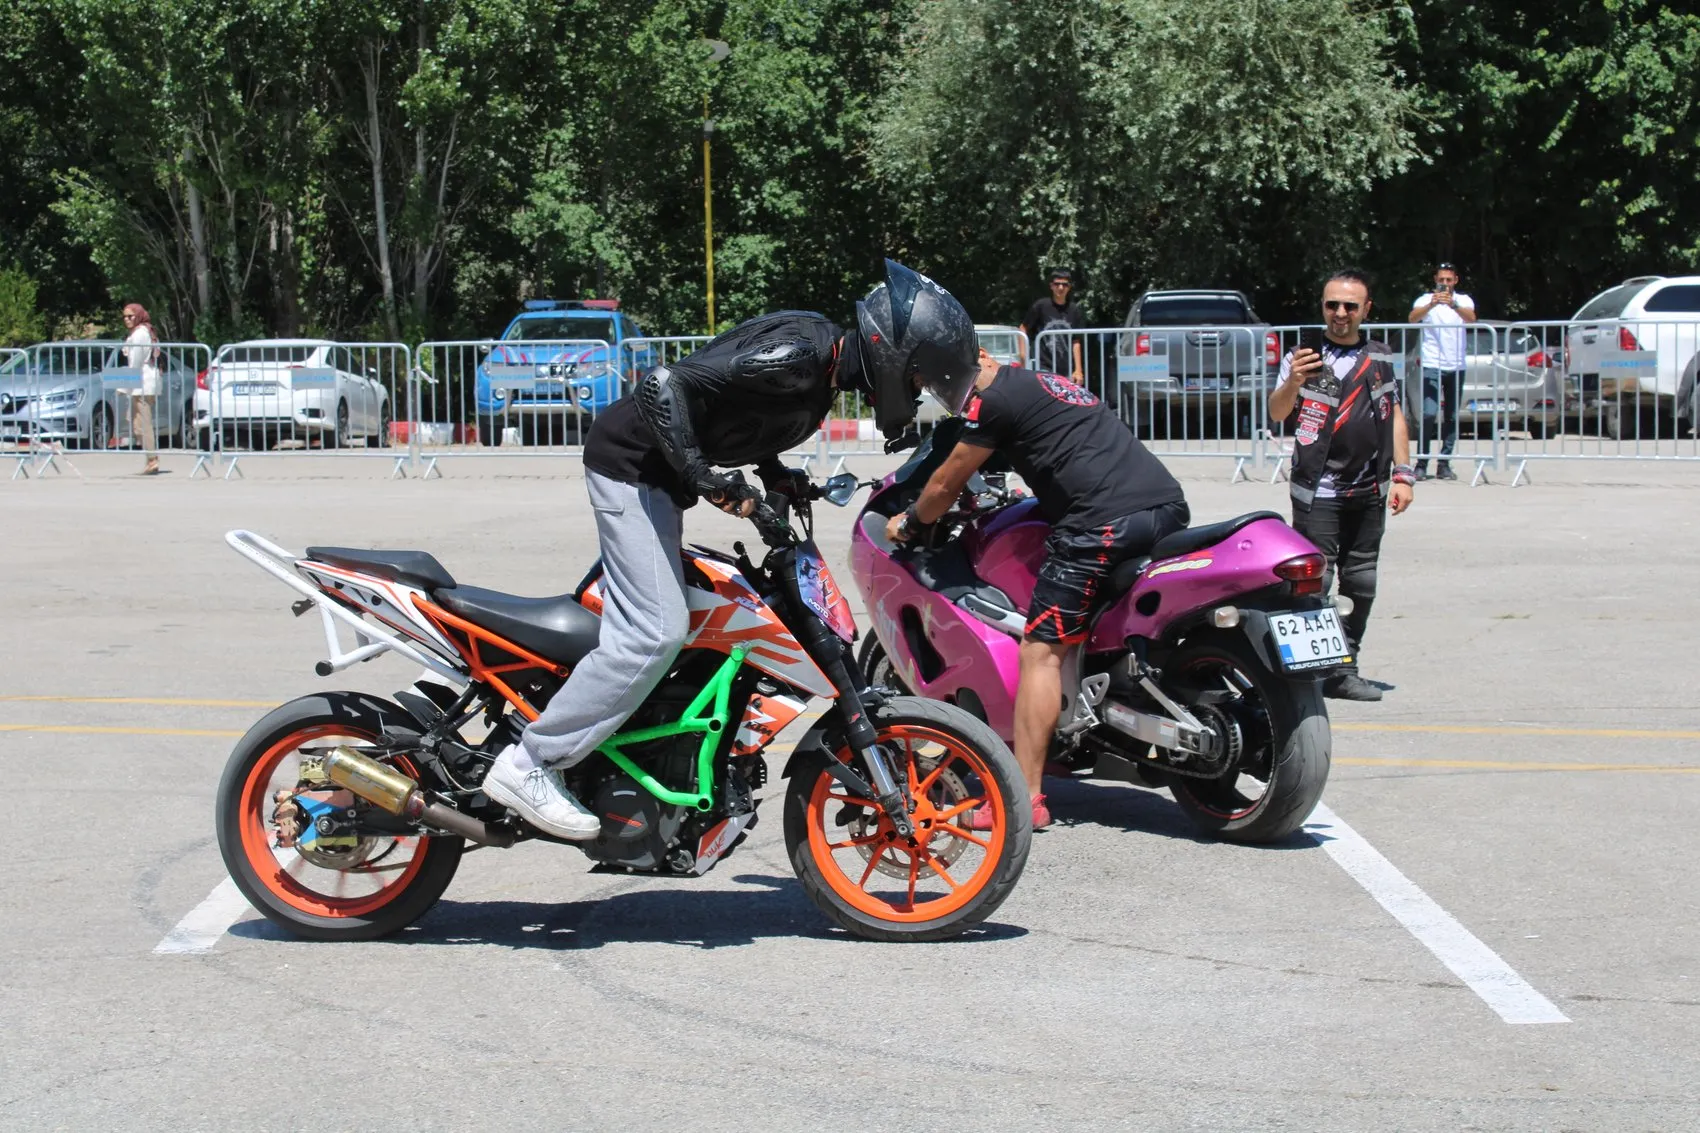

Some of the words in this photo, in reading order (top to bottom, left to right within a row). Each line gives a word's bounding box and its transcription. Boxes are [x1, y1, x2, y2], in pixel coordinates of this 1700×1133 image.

[809, 598, 829, 618] MOTO
[1277, 620, 1299, 636] 62
[1304, 613, 1336, 633] AAH
[1311, 637, 1342, 655] 670
[744, 721, 773, 735] KTM
